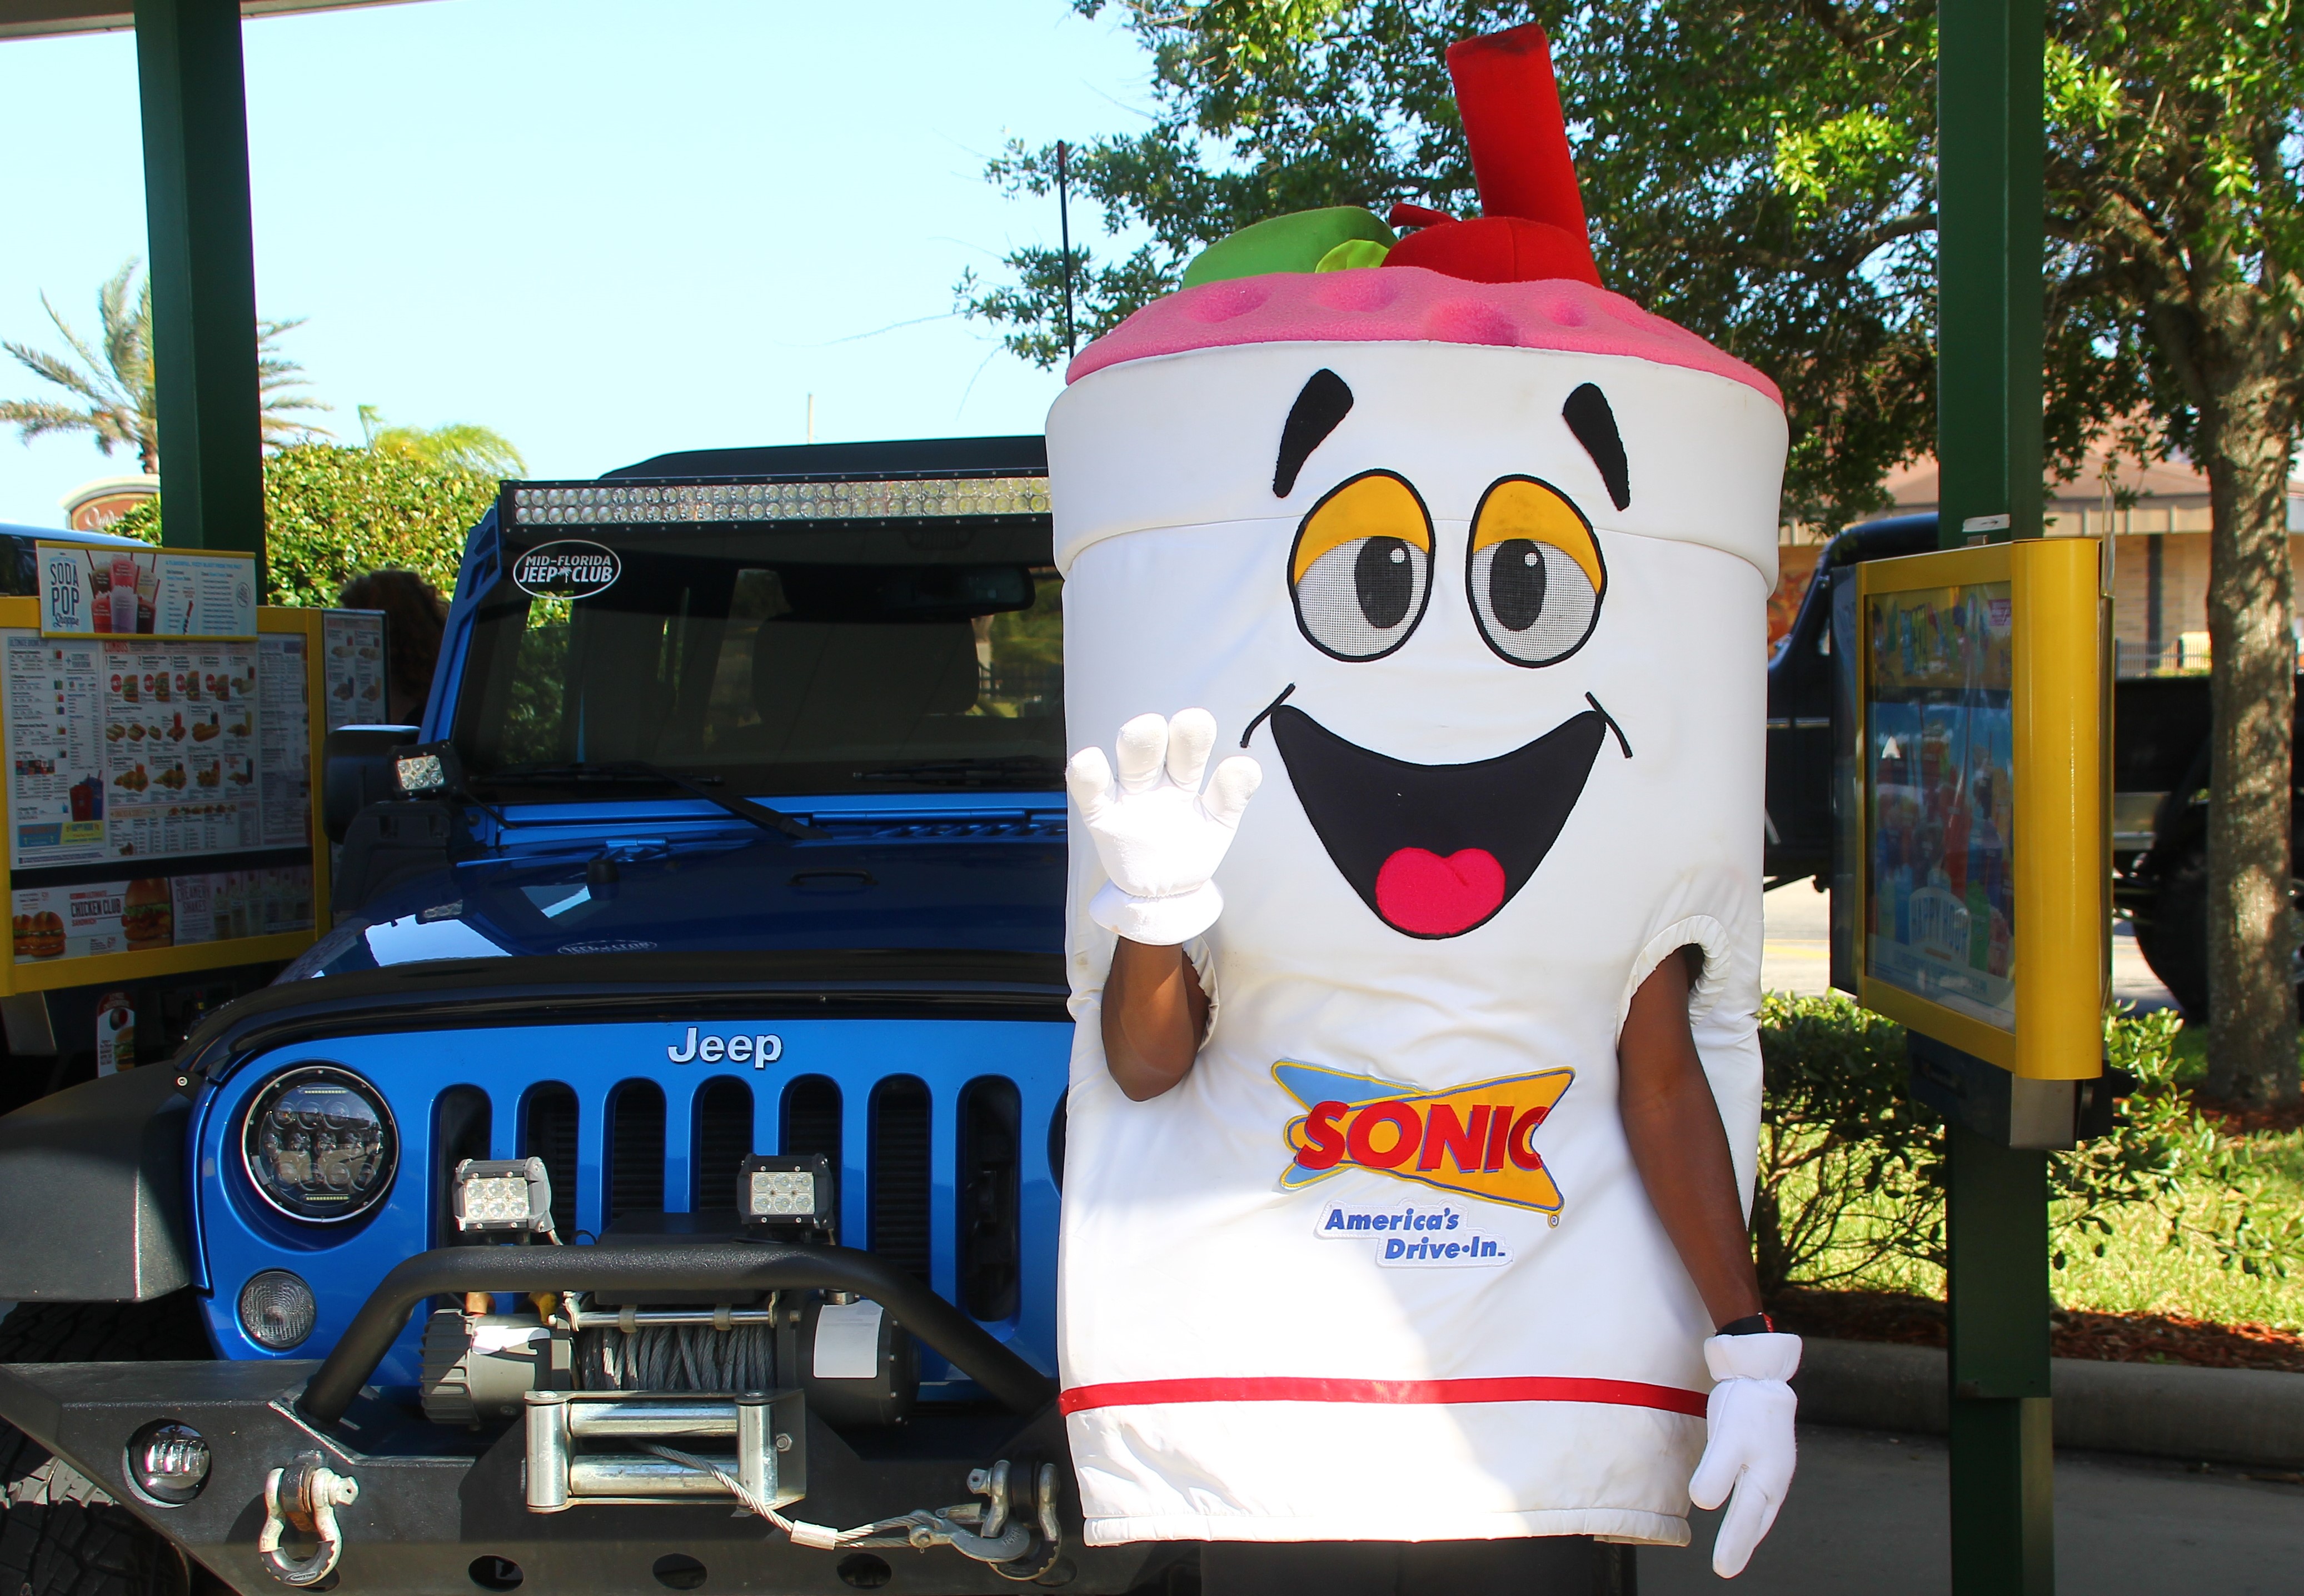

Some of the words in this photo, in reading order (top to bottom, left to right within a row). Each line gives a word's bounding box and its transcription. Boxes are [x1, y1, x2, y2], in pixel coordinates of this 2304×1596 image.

[525, 556, 611, 566] MID-FLORIDA
[50, 562, 79, 587] SODA
[519, 566, 558, 582] JEEP
[572, 566, 612, 582] CLUB
[52, 586, 79, 616] POP
[71, 900, 102, 918] CHICKEN
[103, 897, 121, 915] CLUB
[667, 1027, 782, 1069] Jeep
[1295, 1100, 1550, 1173] SONIC
[1324, 1208, 1459, 1231] America's
